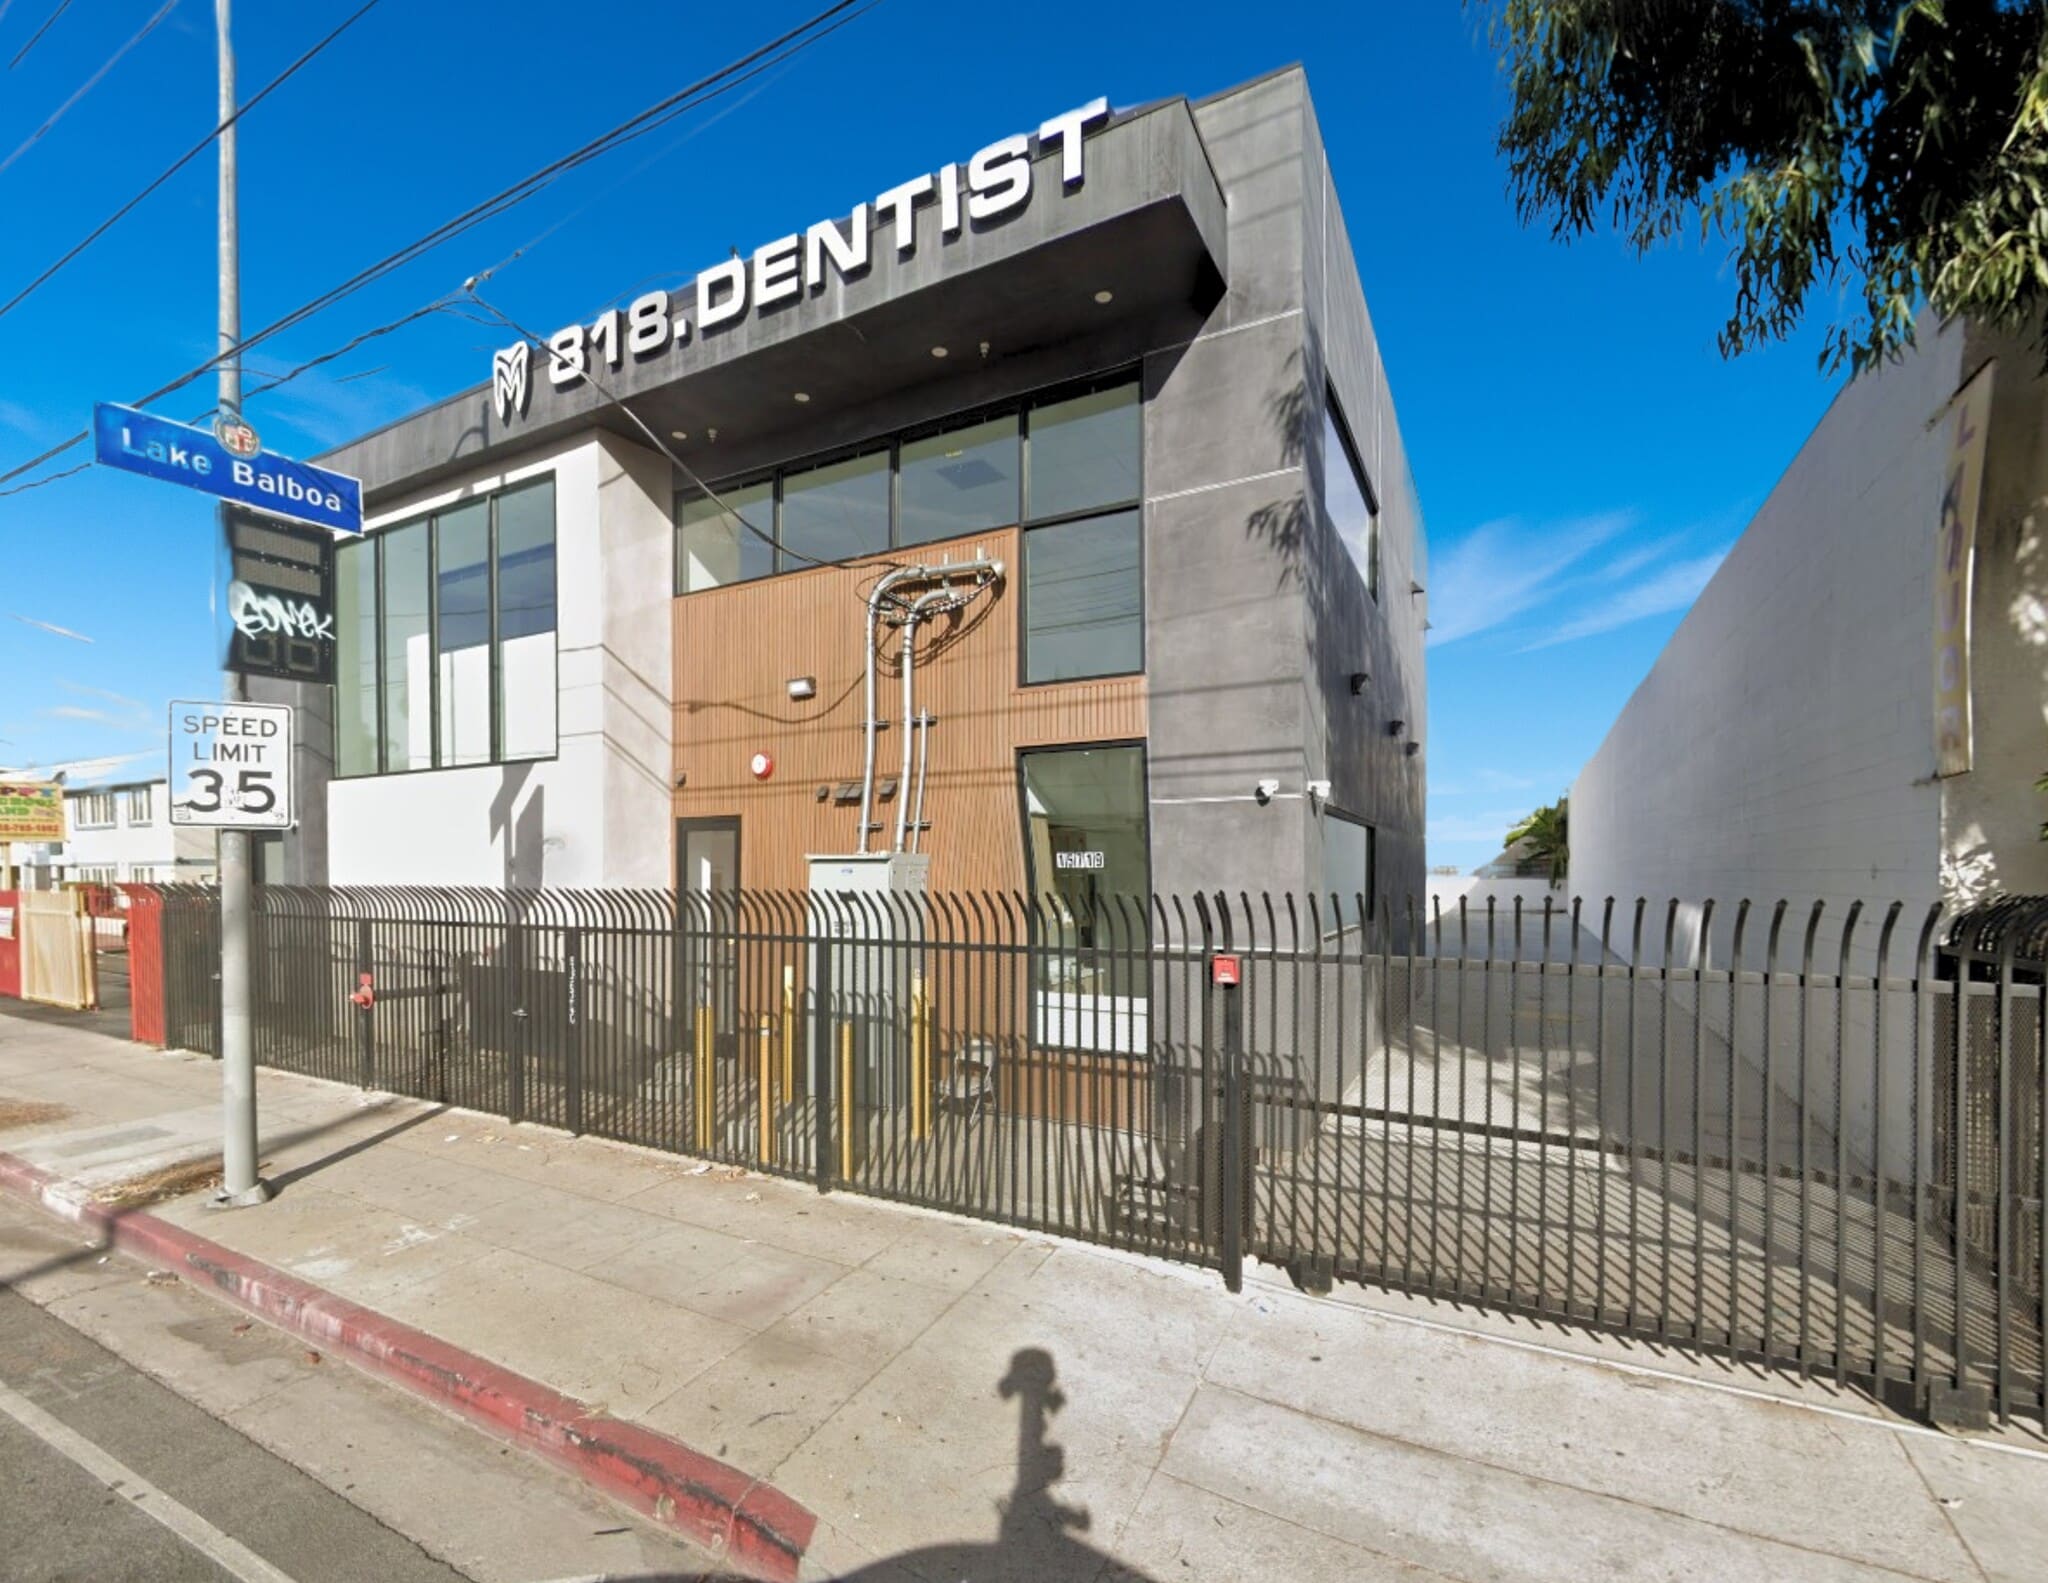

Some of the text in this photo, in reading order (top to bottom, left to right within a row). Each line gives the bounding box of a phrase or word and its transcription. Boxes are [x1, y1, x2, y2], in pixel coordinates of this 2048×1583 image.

[548, 96, 1110, 386] 818.DENTIST
[121, 427, 342, 513] Lake Balboa
[183, 715, 278, 738] SPEED
[193, 741, 267, 763] LIMIT
[187, 768, 276, 814] 35
